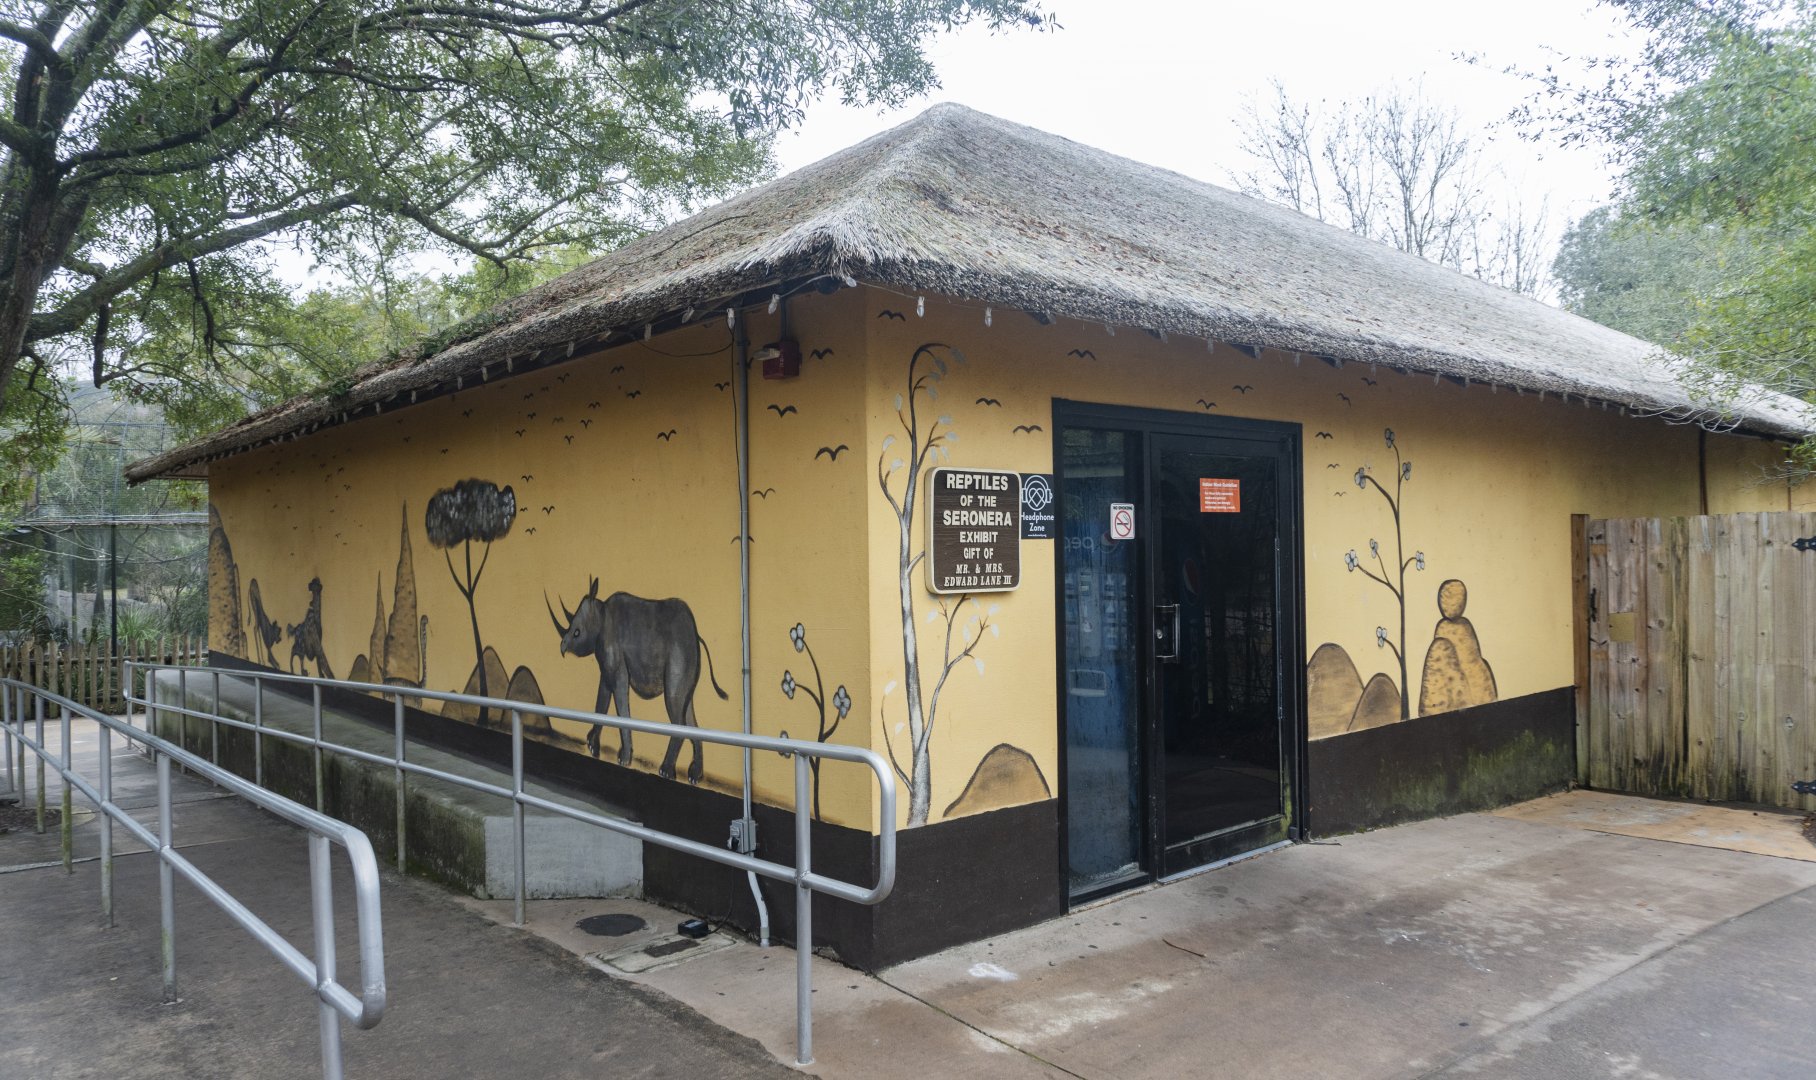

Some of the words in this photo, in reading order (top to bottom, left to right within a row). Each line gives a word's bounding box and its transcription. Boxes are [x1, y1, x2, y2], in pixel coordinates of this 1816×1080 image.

[946, 473, 1009, 491] REPTILES
[960, 495, 973, 507] OF
[978, 495, 997, 508] THE
[943, 510, 1013, 527] SERONERA
[1020, 511, 1055, 524] Headphone
[1029, 522, 1046, 532] Zone
[959, 531, 999, 543] EXHIBIT
[963, 548, 980, 560] GIFT
[983, 547, 994, 559] OF
[956, 564, 971, 575] MR.
[975, 563, 981, 574] &
[985, 563, 1004, 573] MRS.
[944, 576, 978, 587] EDWARD
[980, 575, 1001, 586] LANE
[1003, 575, 1012, 585] III
